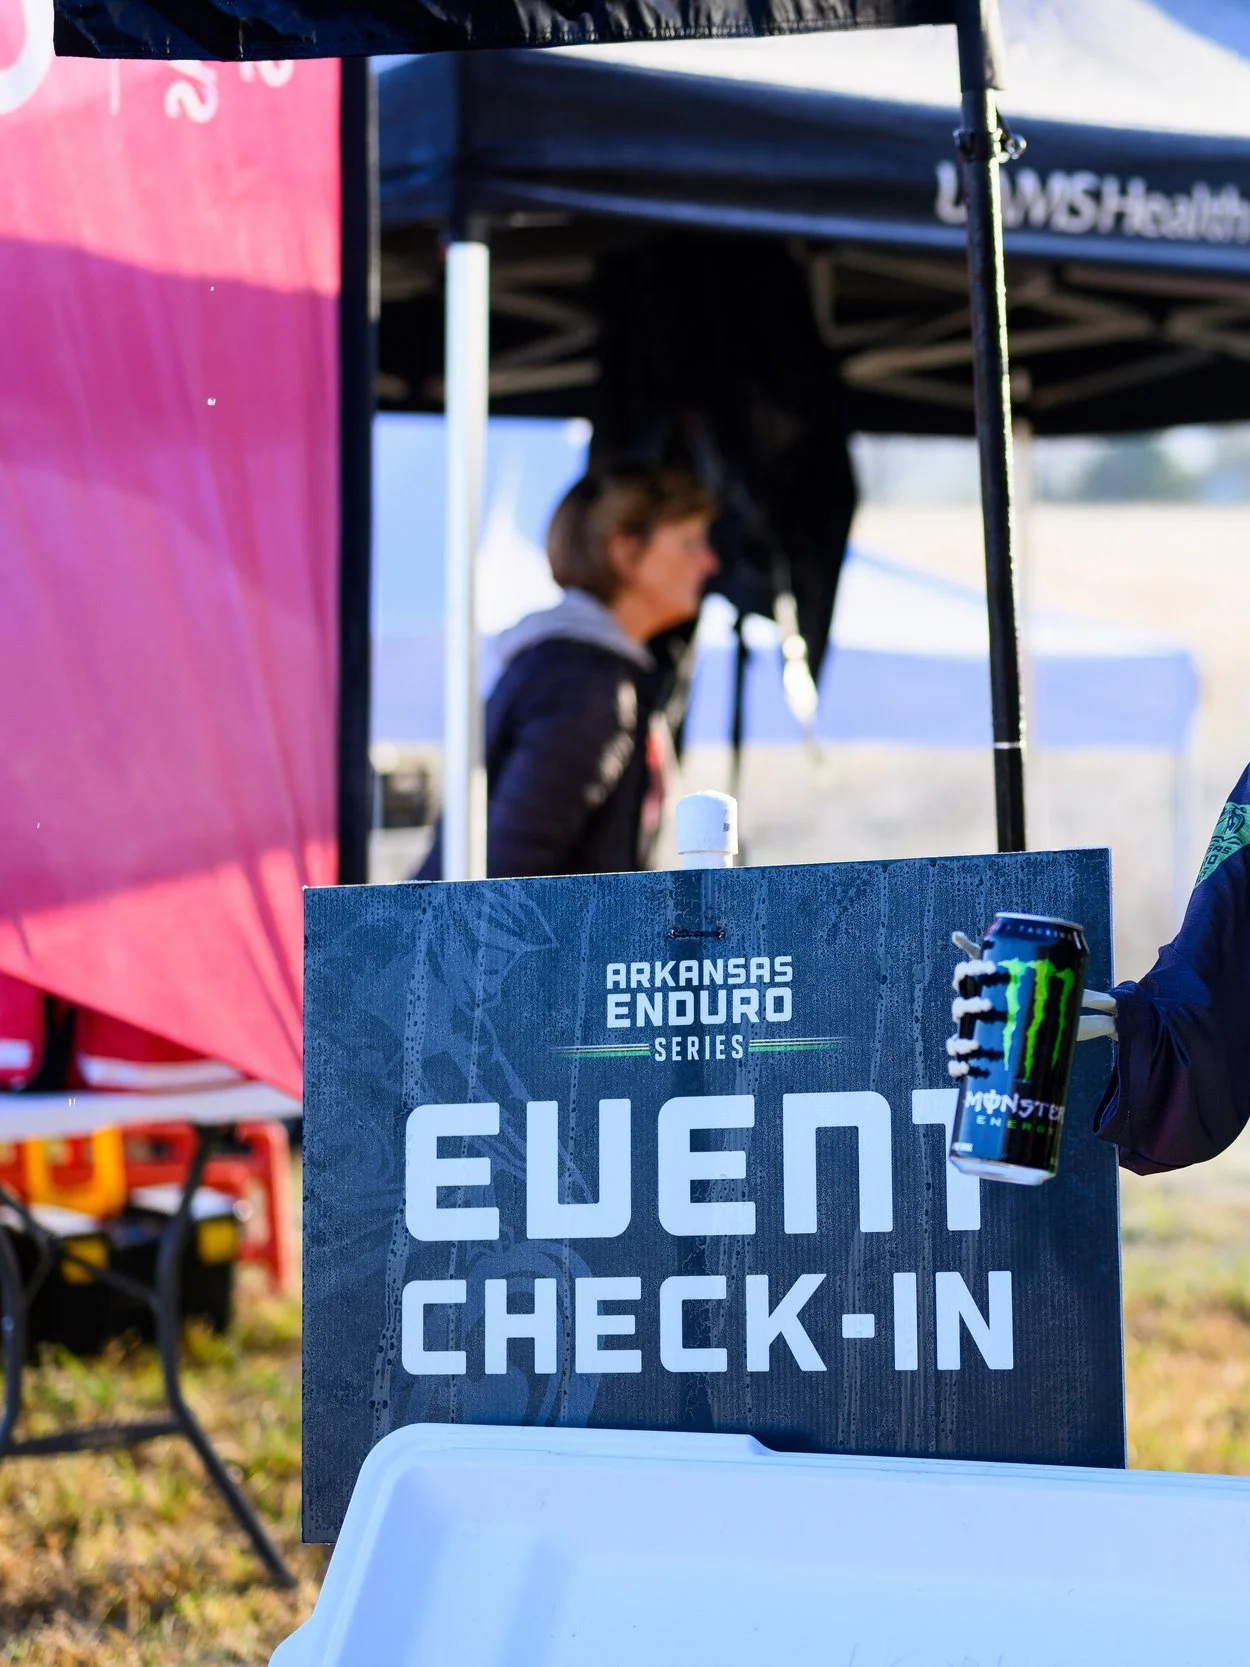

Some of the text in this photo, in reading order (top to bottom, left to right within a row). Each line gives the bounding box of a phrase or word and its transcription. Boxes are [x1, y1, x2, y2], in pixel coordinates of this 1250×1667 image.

[606, 956, 793, 989] ARKANSAS
[606, 987, 793, 1028] ENDURO
[654, 1035, 744, 1061] SERIES
[401, 1271, 1014, 1375] CHECK-IN
